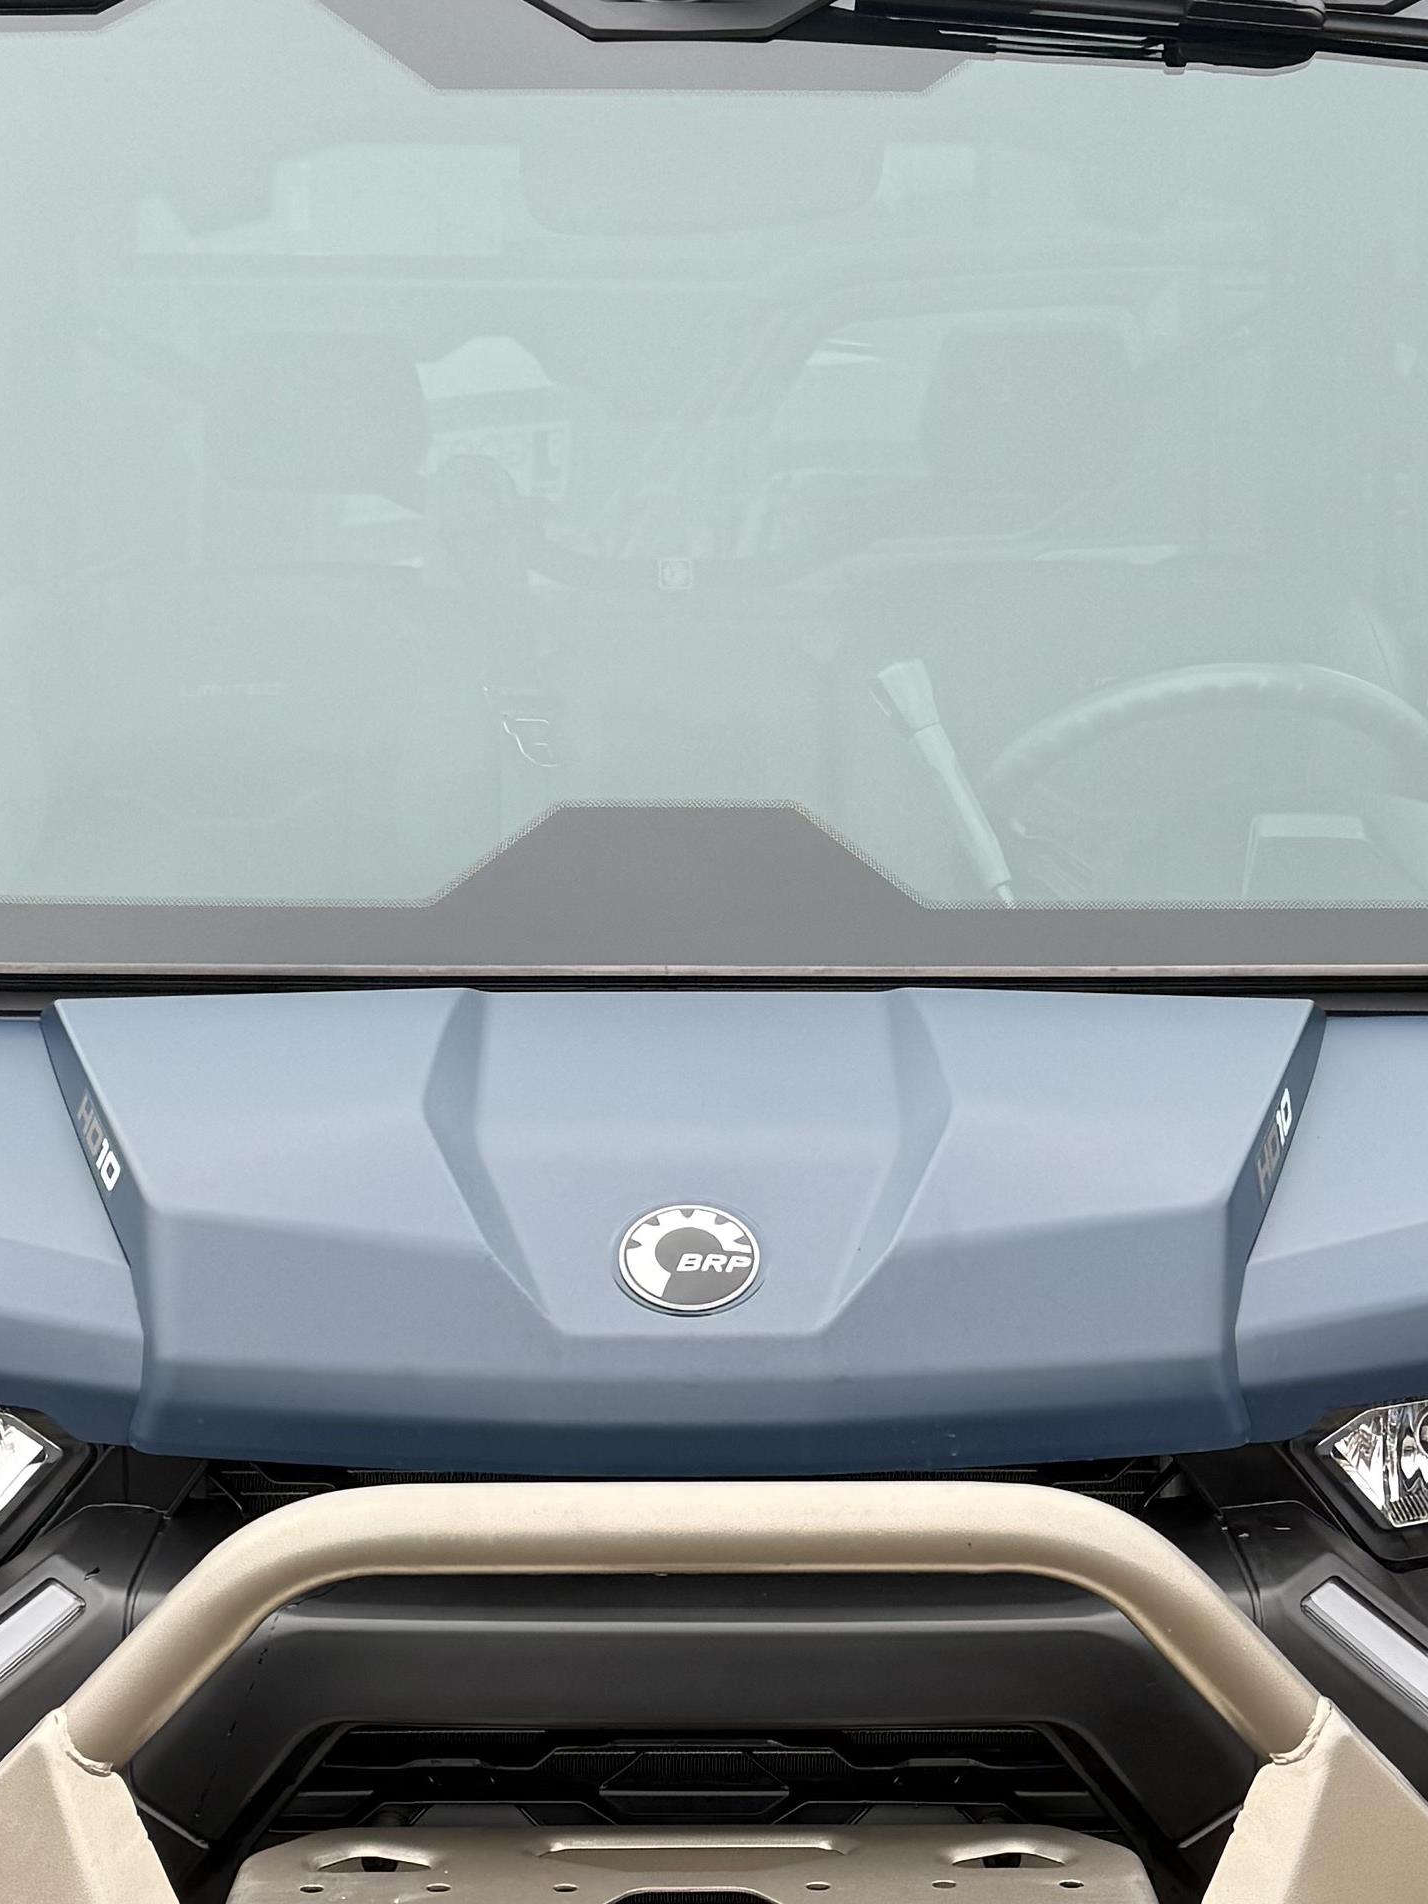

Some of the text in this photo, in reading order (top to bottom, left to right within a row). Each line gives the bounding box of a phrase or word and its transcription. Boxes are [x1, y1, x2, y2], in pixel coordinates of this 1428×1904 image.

[77, 1087, 121, 1192] HD10
[1257, 1087, 1292, 1201] HD10
[676, 1253, 752, 1273] BRP
